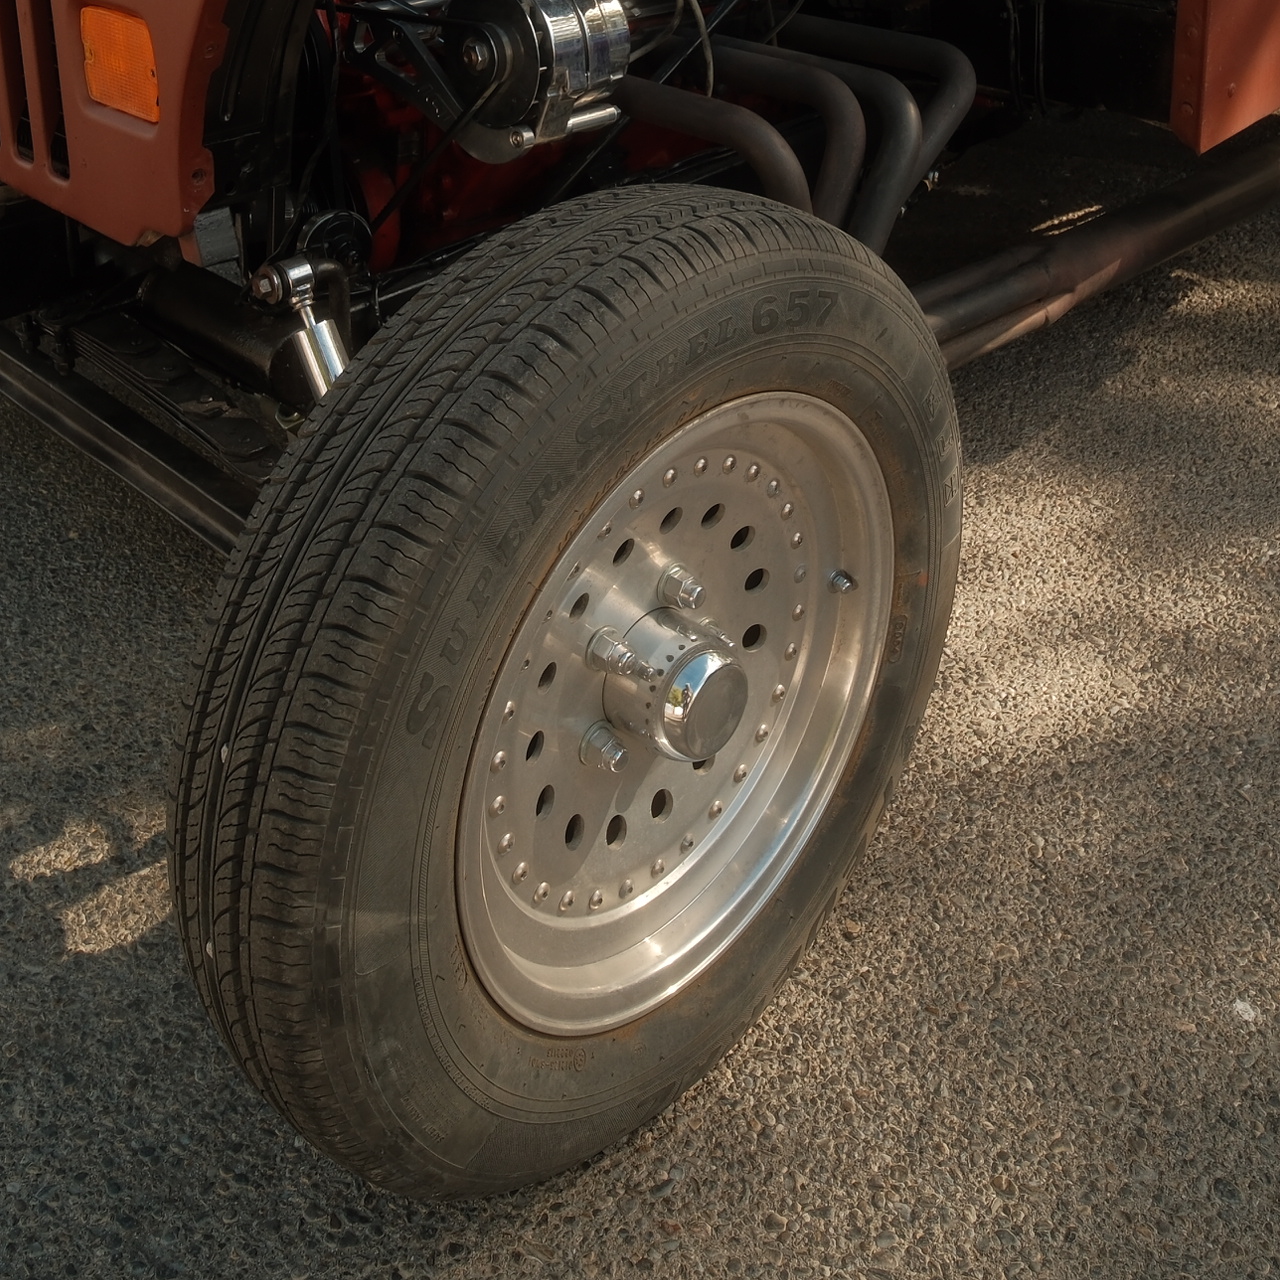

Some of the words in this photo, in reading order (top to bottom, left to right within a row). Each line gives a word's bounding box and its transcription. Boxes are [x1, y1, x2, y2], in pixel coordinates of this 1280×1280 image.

[406, 472, 569, 750] SUPER
[576, 315, 742, 473] STEEL
[752, 290, 839, 335] 657
